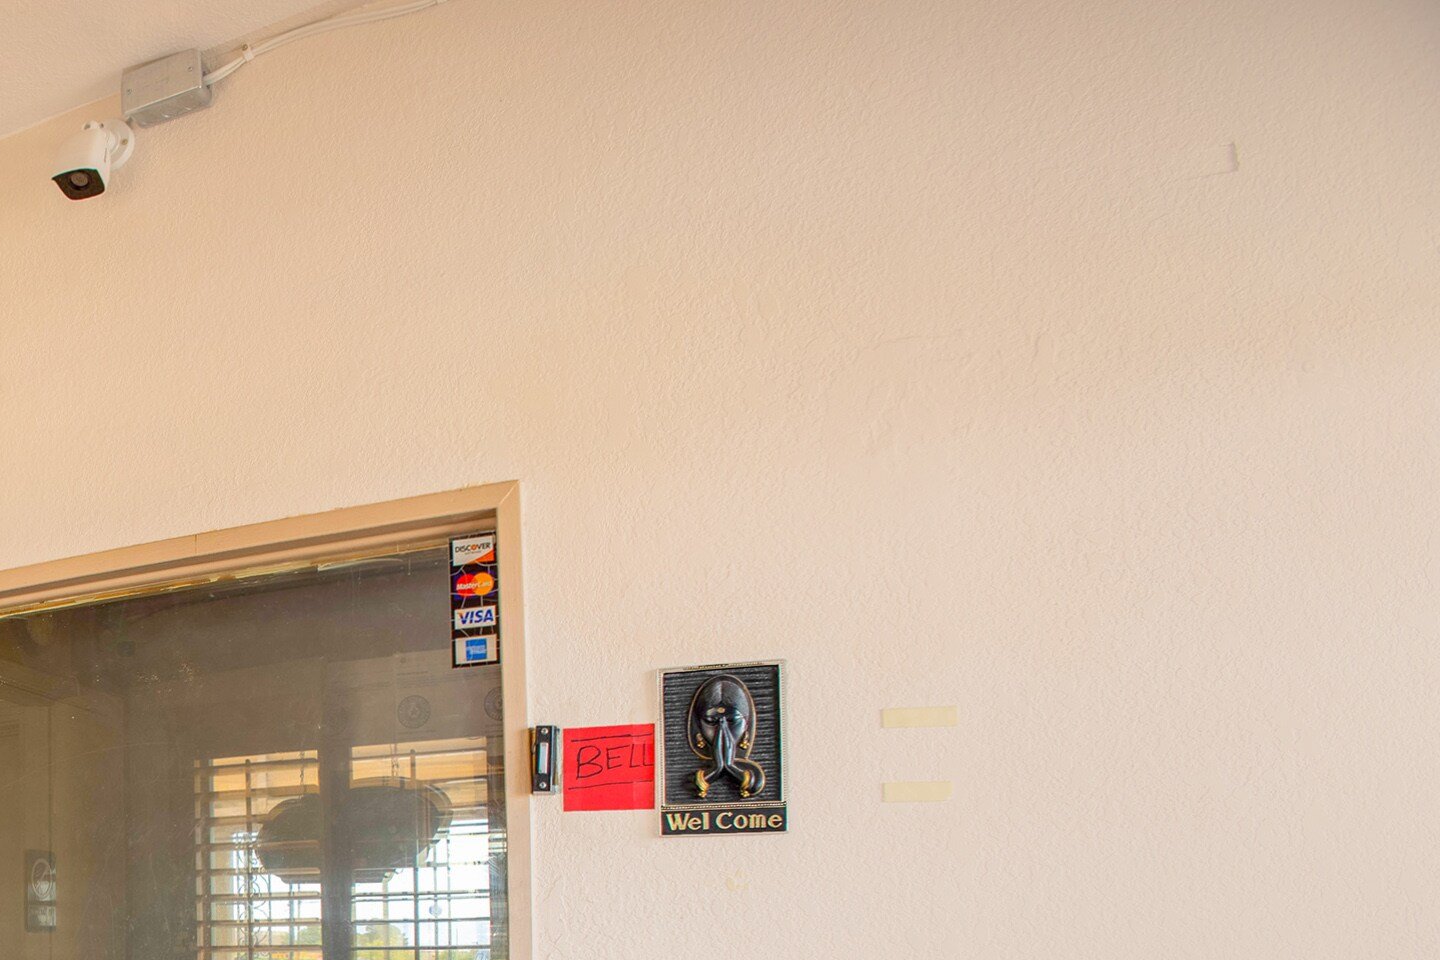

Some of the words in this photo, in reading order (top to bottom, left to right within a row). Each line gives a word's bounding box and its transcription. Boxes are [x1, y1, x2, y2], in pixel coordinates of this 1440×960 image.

[455, 542, 491, 553] DISCOVER
[459, 609, 494, 625] VISA
[576, 744, 654, 780] BELL
